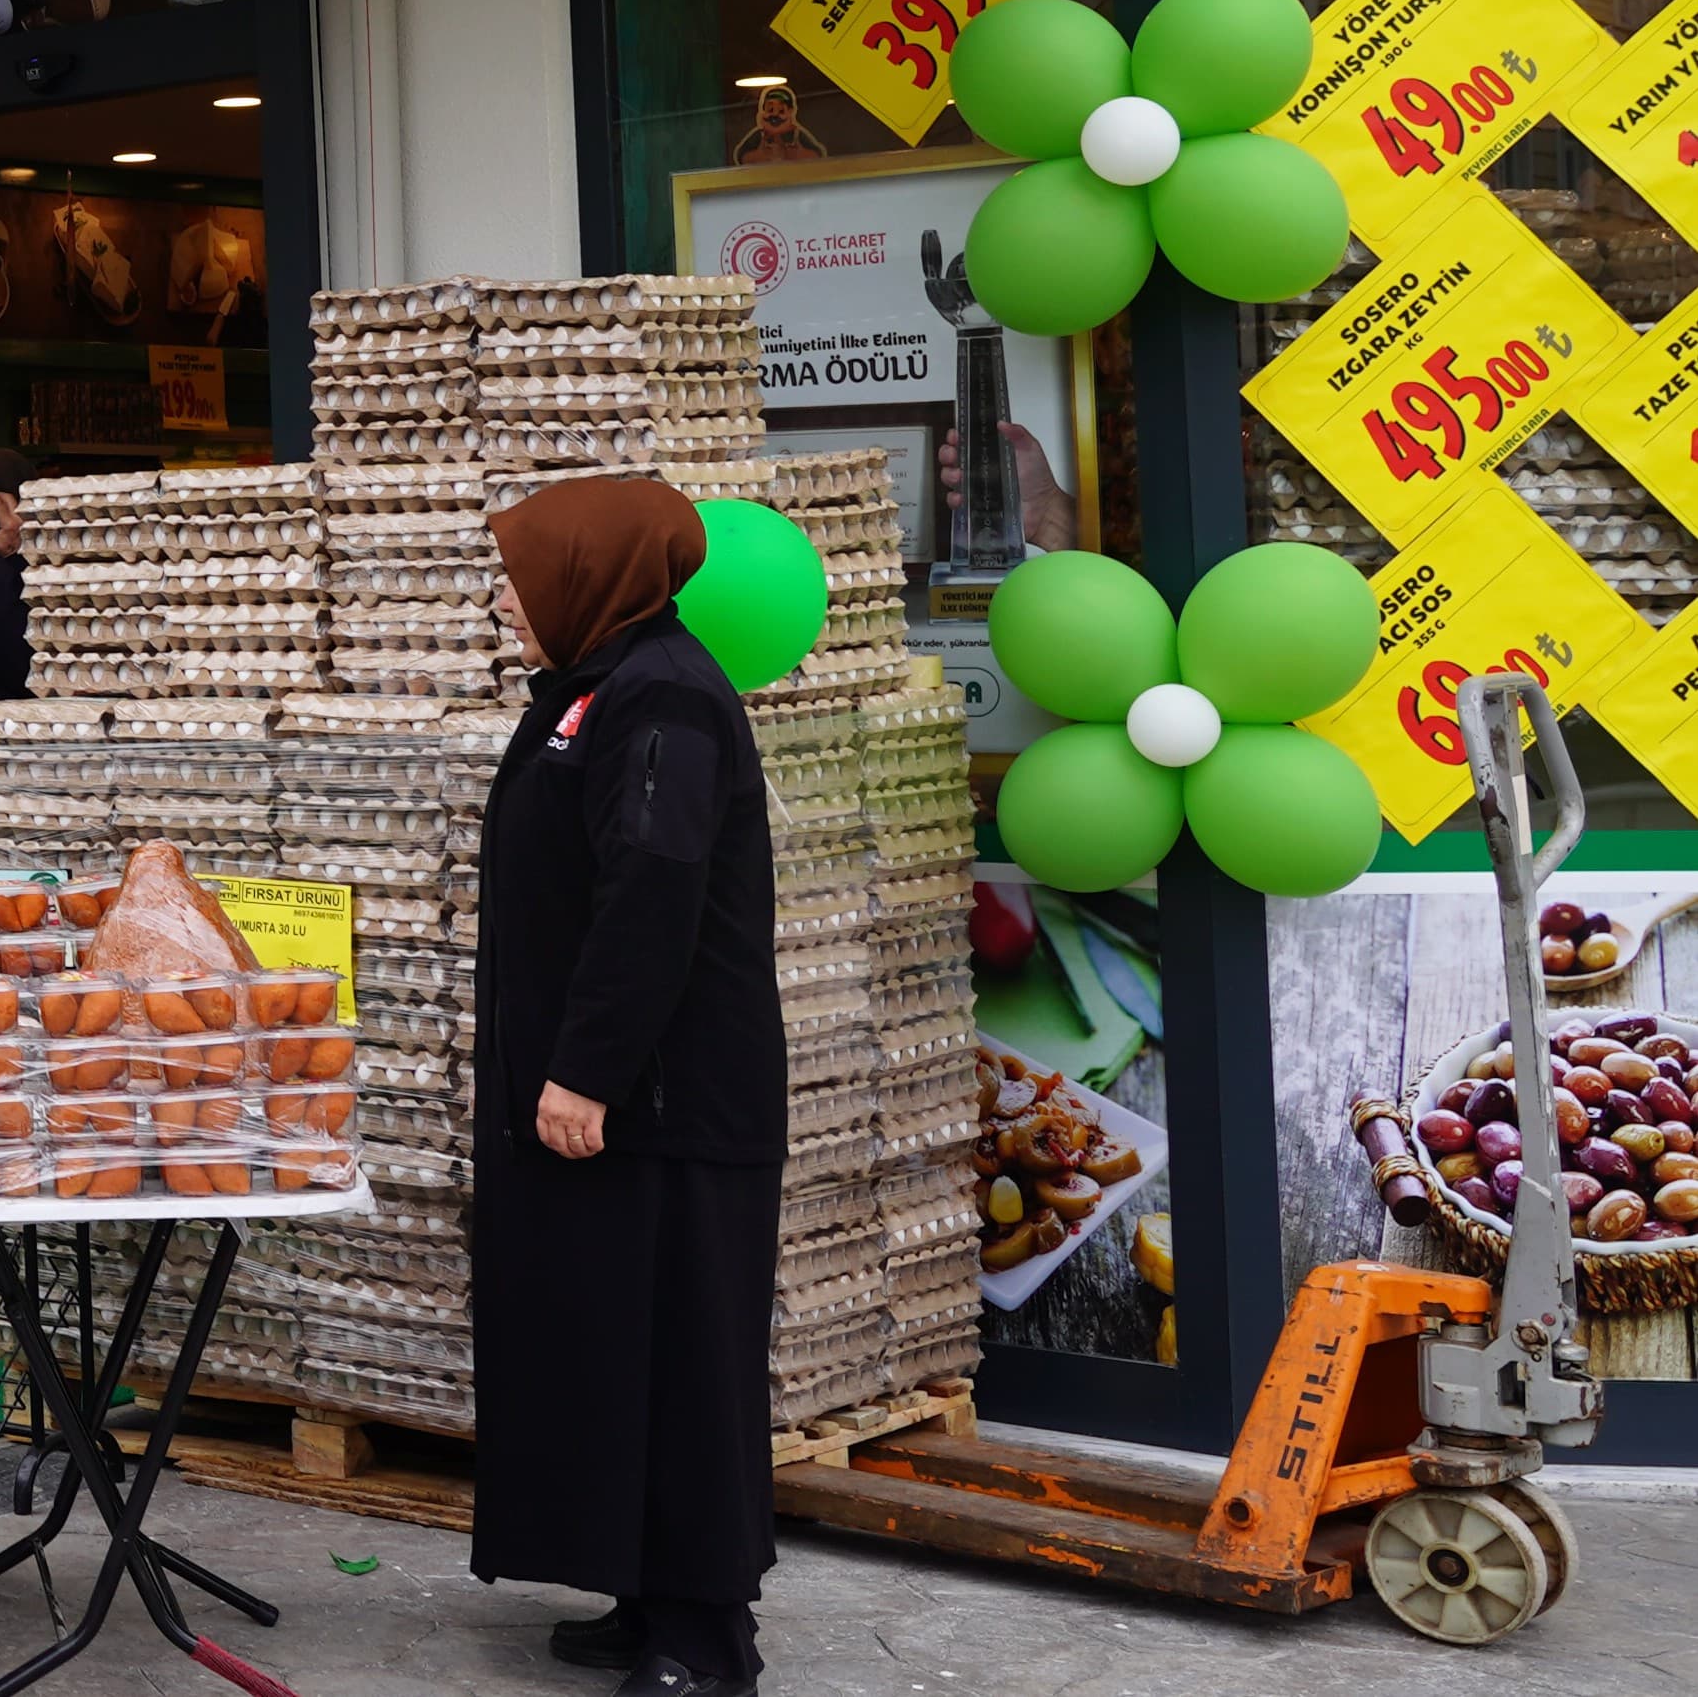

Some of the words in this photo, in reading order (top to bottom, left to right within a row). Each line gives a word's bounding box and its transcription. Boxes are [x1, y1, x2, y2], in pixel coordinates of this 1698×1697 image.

[1379, 46, 1403, 69] 190
[1286, 30, 1390, 125] KORNİŞON
[1609, 74, 1679, 135] YARIM
[1361, 65, 1514, 178] 49.00
[1503, 118, 1532, 144] BABA
[795, 240, 820, 252] T.C.
[825, 233, 887, 249] TİCARET
[797, 249, 885, 270] BAKANLIĞI
[1340, 272, 1419, 345] SOSERO
[840, 333, 868, 349] İlke
[873, 333, 927, 346] Edinen
[1326, 325, 1403, 393] IZGARA
[1398, 261, 1472, 329] ZEYTİN
[1405, 332, 1424, 351] KG
[825, 350, 928, 384] ÖDÜLÜ
[1361, 340, 1550, 483] 495.00
[1633, 373, 1691, 422] TAZE
[1521, 408, 1551, 435] BABA
[1379, 619, 1414, 655] ACI
[1410, 583, 1452, 624] SOS
[1412, 627, 1436, 650] 355
[245, 887, 292, 901] FIRSAT
[296, 889, 340, 907] ÜRÜNÜ
[232, 919, 276, 934] UMURTA
[279, 923, 290, 934] 30
[293, 925, 306, 936] LU
[1277, 1335, 1341, 1482] STILL
